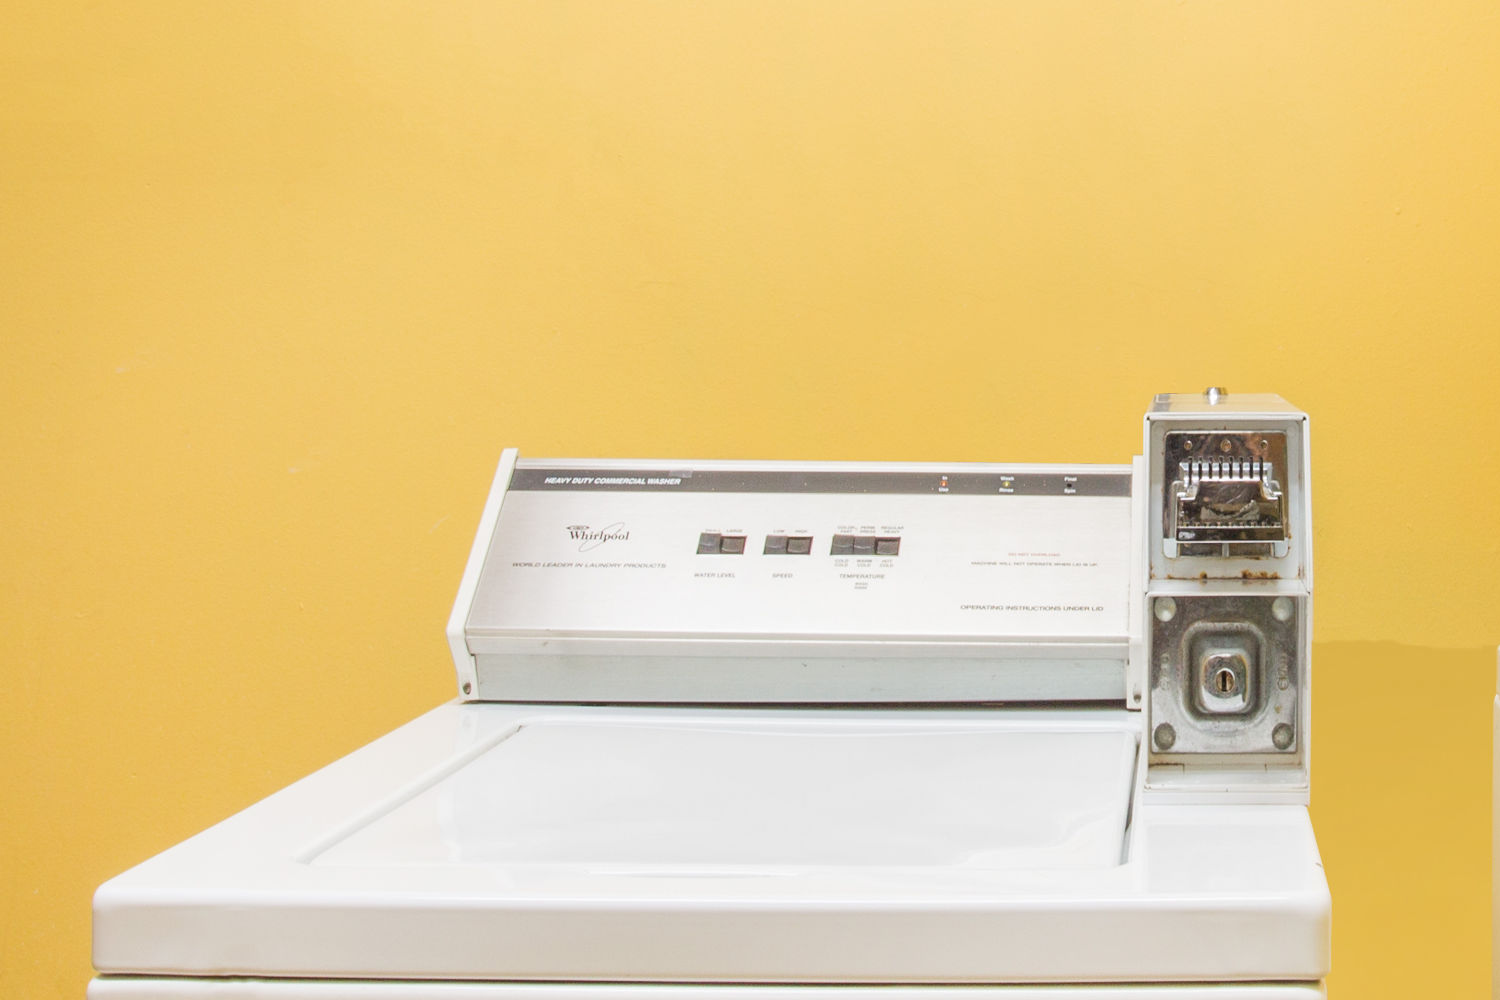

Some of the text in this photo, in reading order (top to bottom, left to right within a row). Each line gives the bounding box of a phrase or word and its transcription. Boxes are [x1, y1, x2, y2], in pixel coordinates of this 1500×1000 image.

[572, 477, 594, 485] DUTY
[594, 477, 646, 485] COMMERCIAL
[647, 478, 681, 486] WASHER
